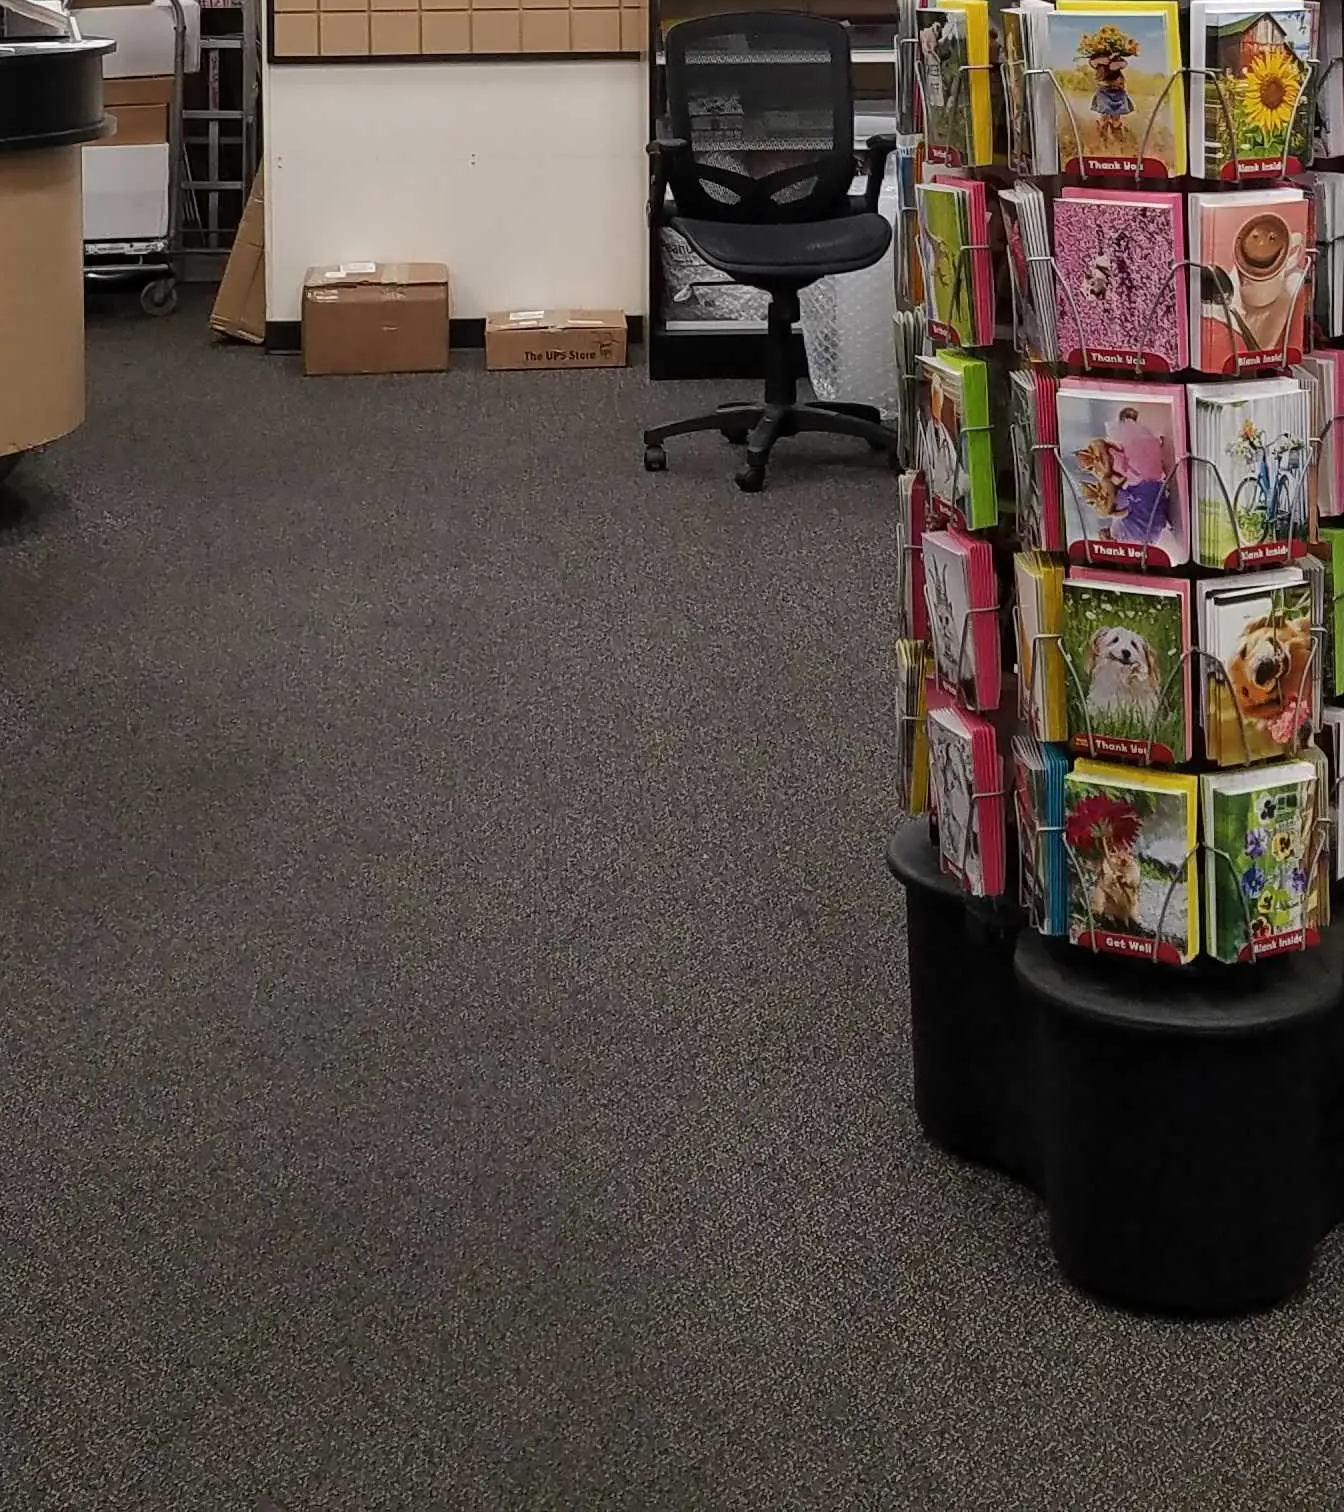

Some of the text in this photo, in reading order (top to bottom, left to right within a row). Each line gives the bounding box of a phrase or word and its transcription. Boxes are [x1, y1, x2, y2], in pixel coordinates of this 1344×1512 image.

[1088, 160, 1122, 172] Thank
[1262, 160, 1284, 172] Insid
[524, 351, 596, 363] The UPS Store
[1091, 352, 1124, 364] Thank
[1262, 352, 1284, 364] Insid
[1093, 544, 1125, 558] Thank
[1095, 740, 1129, 753] Thank
[1106, 937, 1153, 954] Get Well
